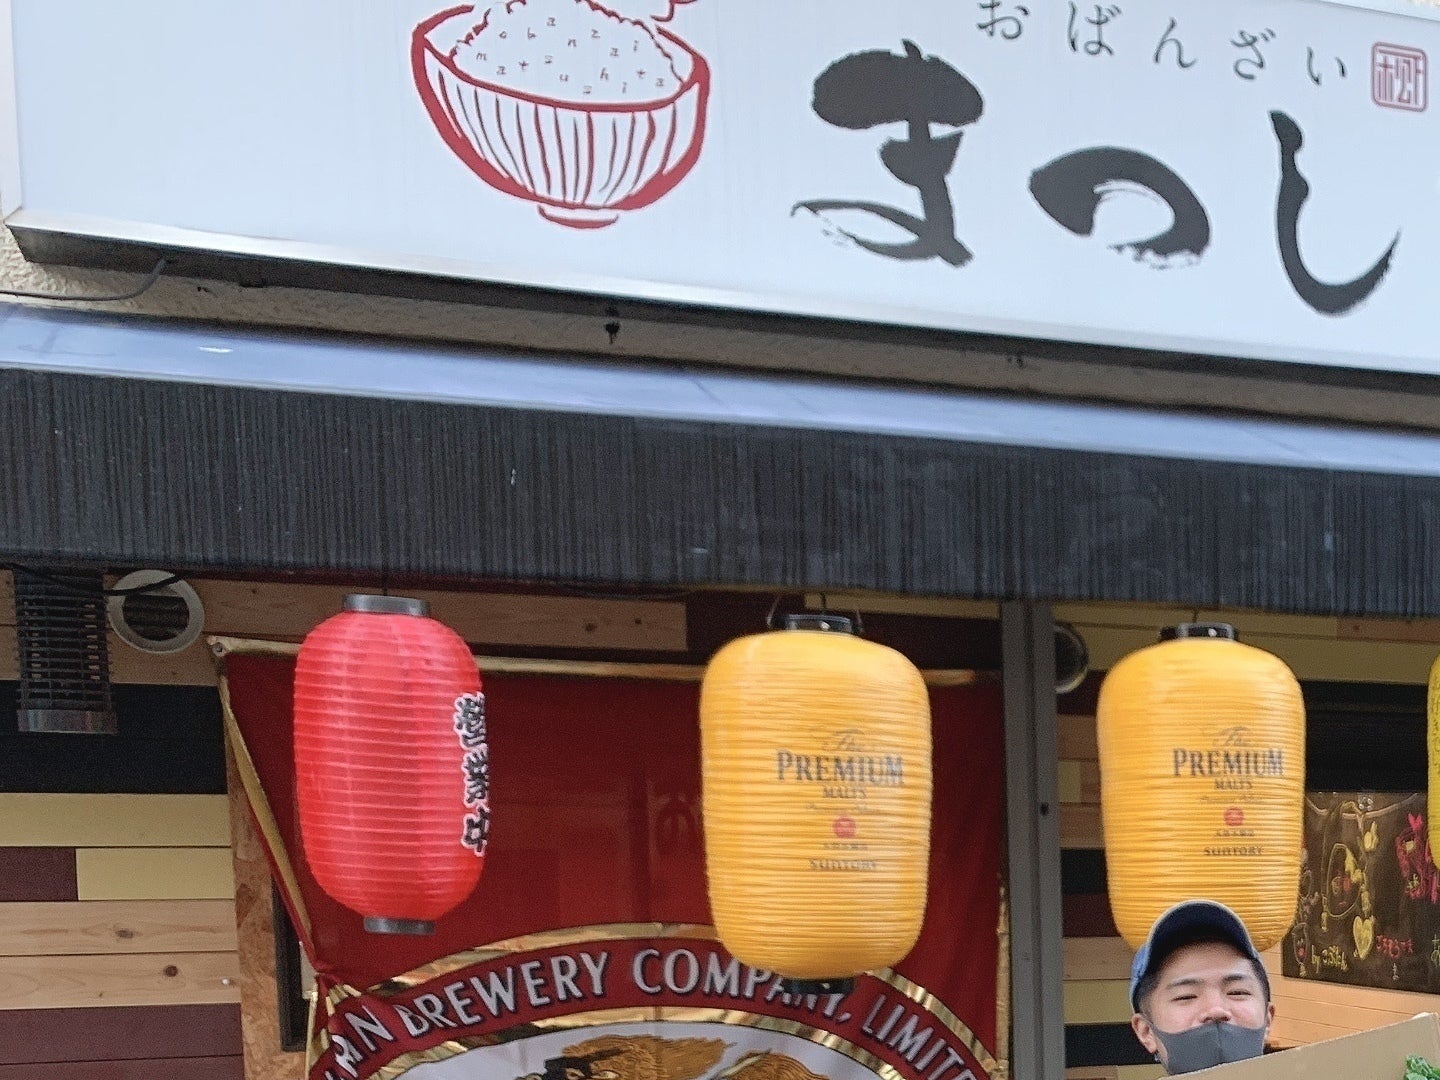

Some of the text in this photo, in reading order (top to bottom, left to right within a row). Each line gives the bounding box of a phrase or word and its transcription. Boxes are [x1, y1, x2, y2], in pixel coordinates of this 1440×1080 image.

[977, 0, 1347, 86] おばんざい
[776, 750, 904, 786] PREMIUM
[1173, 748, 1284, 777] PREMIUM
[395, 951, 609, 1037] BREWERY
[631, 948, 854, 1023] COMPY,
